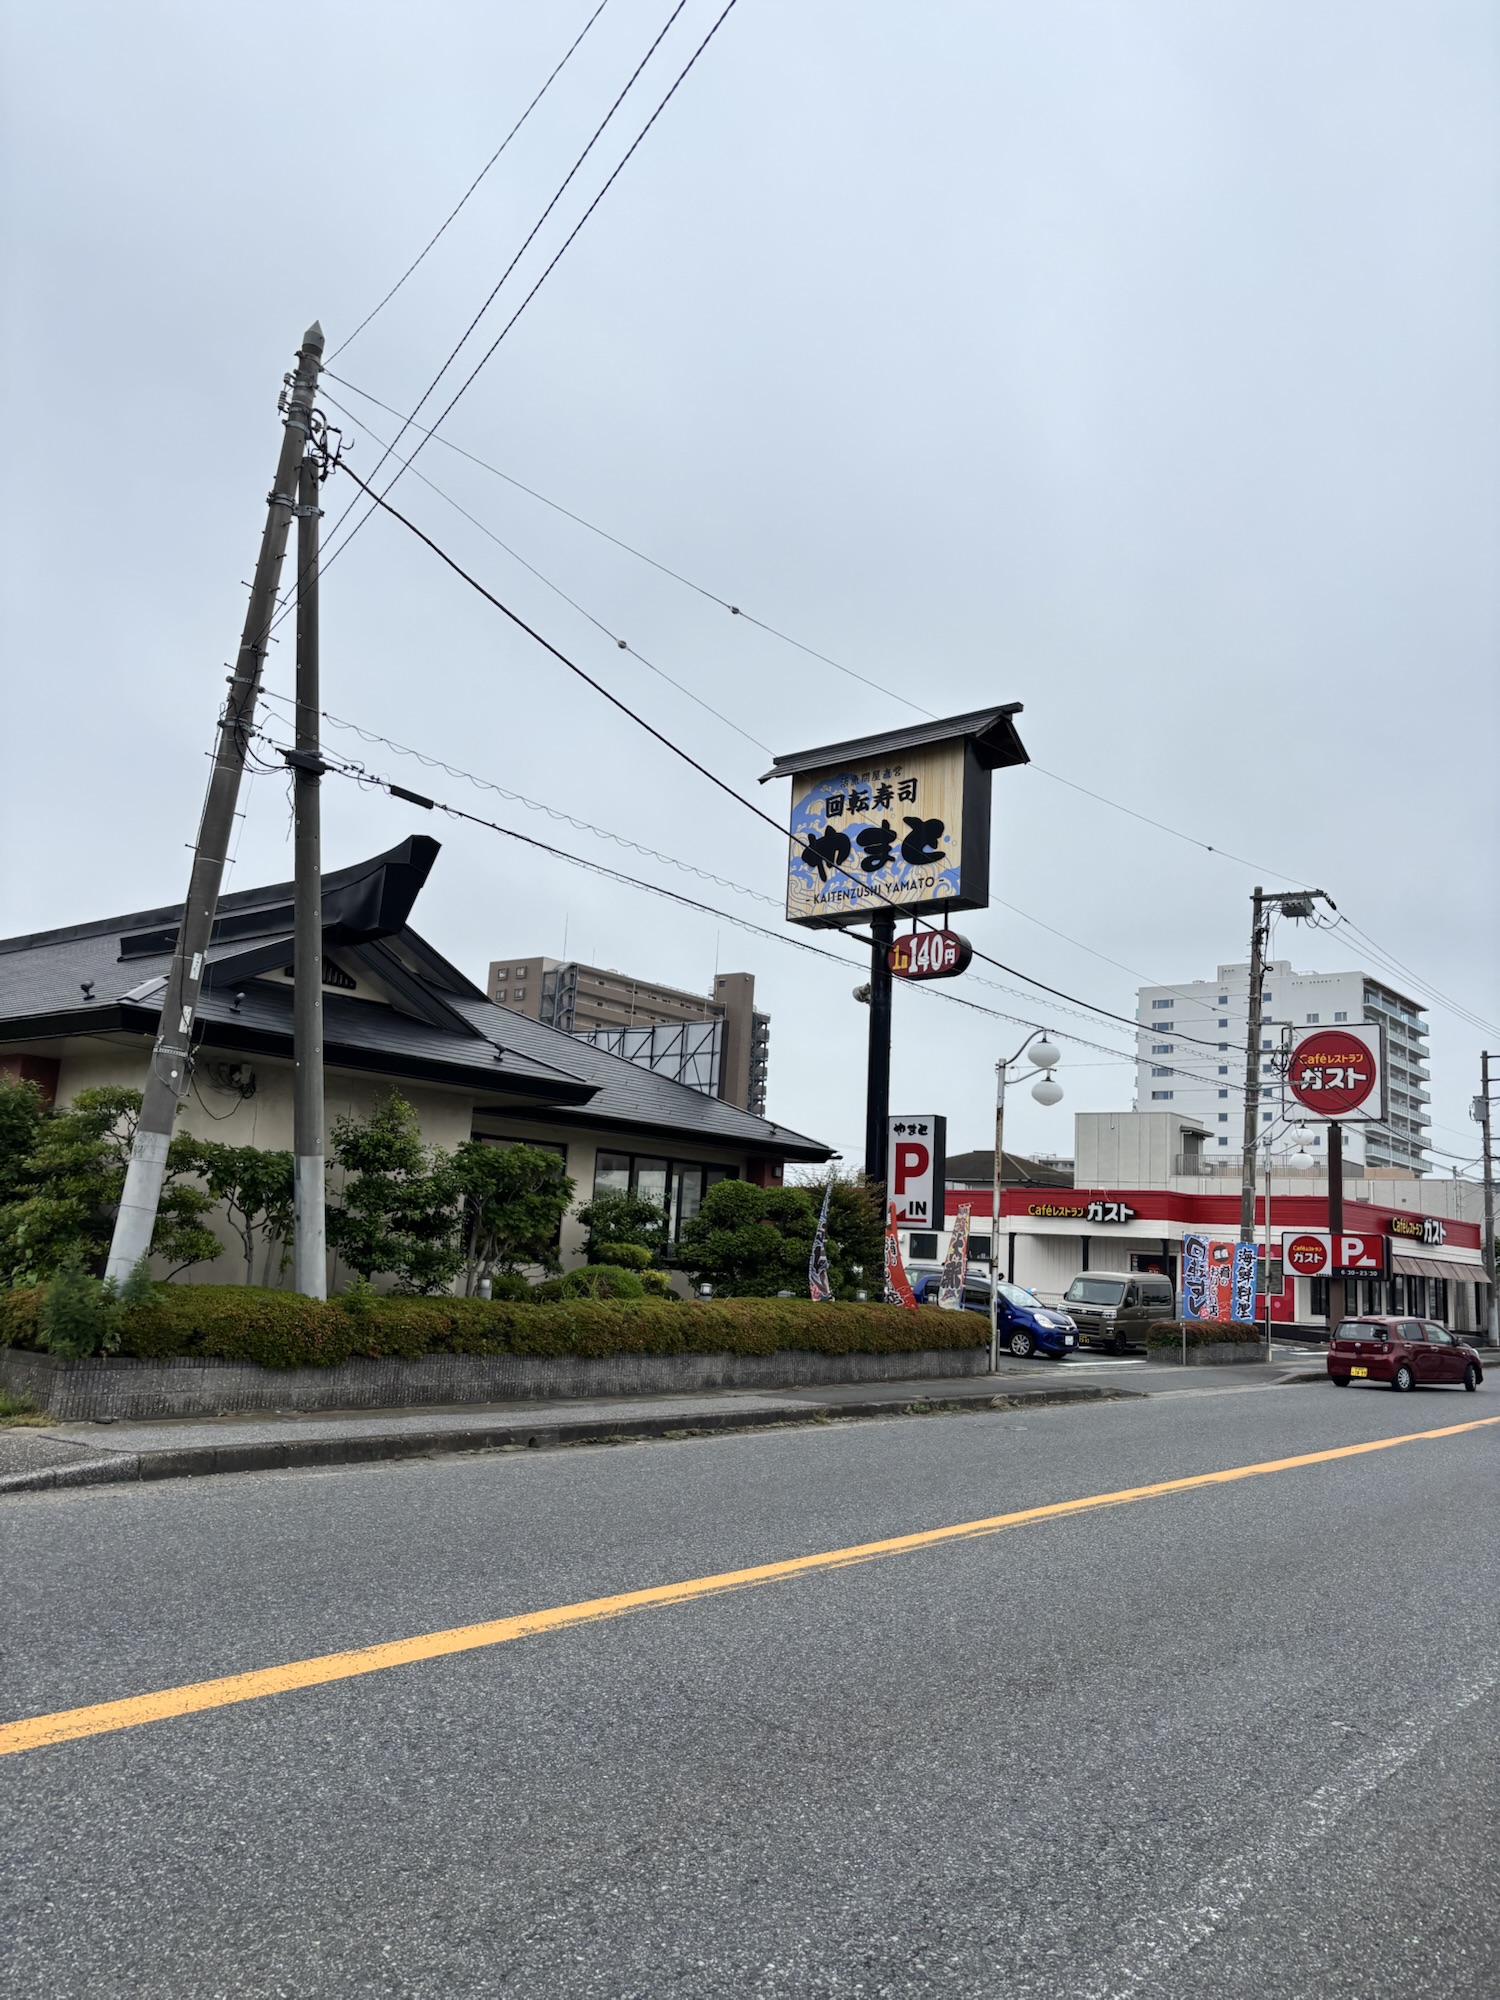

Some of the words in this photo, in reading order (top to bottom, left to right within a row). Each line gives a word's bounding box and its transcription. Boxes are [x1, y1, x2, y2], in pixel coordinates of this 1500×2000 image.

[825, 777, 918, 818] 回転寿司
[801, 816, 945, 882] やまと
[813, 884, 881, 904] KAITENZUSHI
[885, 876, 934, 893] YAMATO
[1300, 1066, 1367, 1091] ガスト
[893, 1122, 928, 1136] やまと
[894, 1142, 929, 1195] P
[909, 1200, 927, 1215] IN
[1087, 1201, 1134, 1222] ガスト
[1423, 1218, 1447, 1245] ガスト
[1293, 1252, 1324, 1264] ガスト
[1341, 1237, 1364, 1266] P
[1236, 1247, 1257, 1319] 海鮮料理
